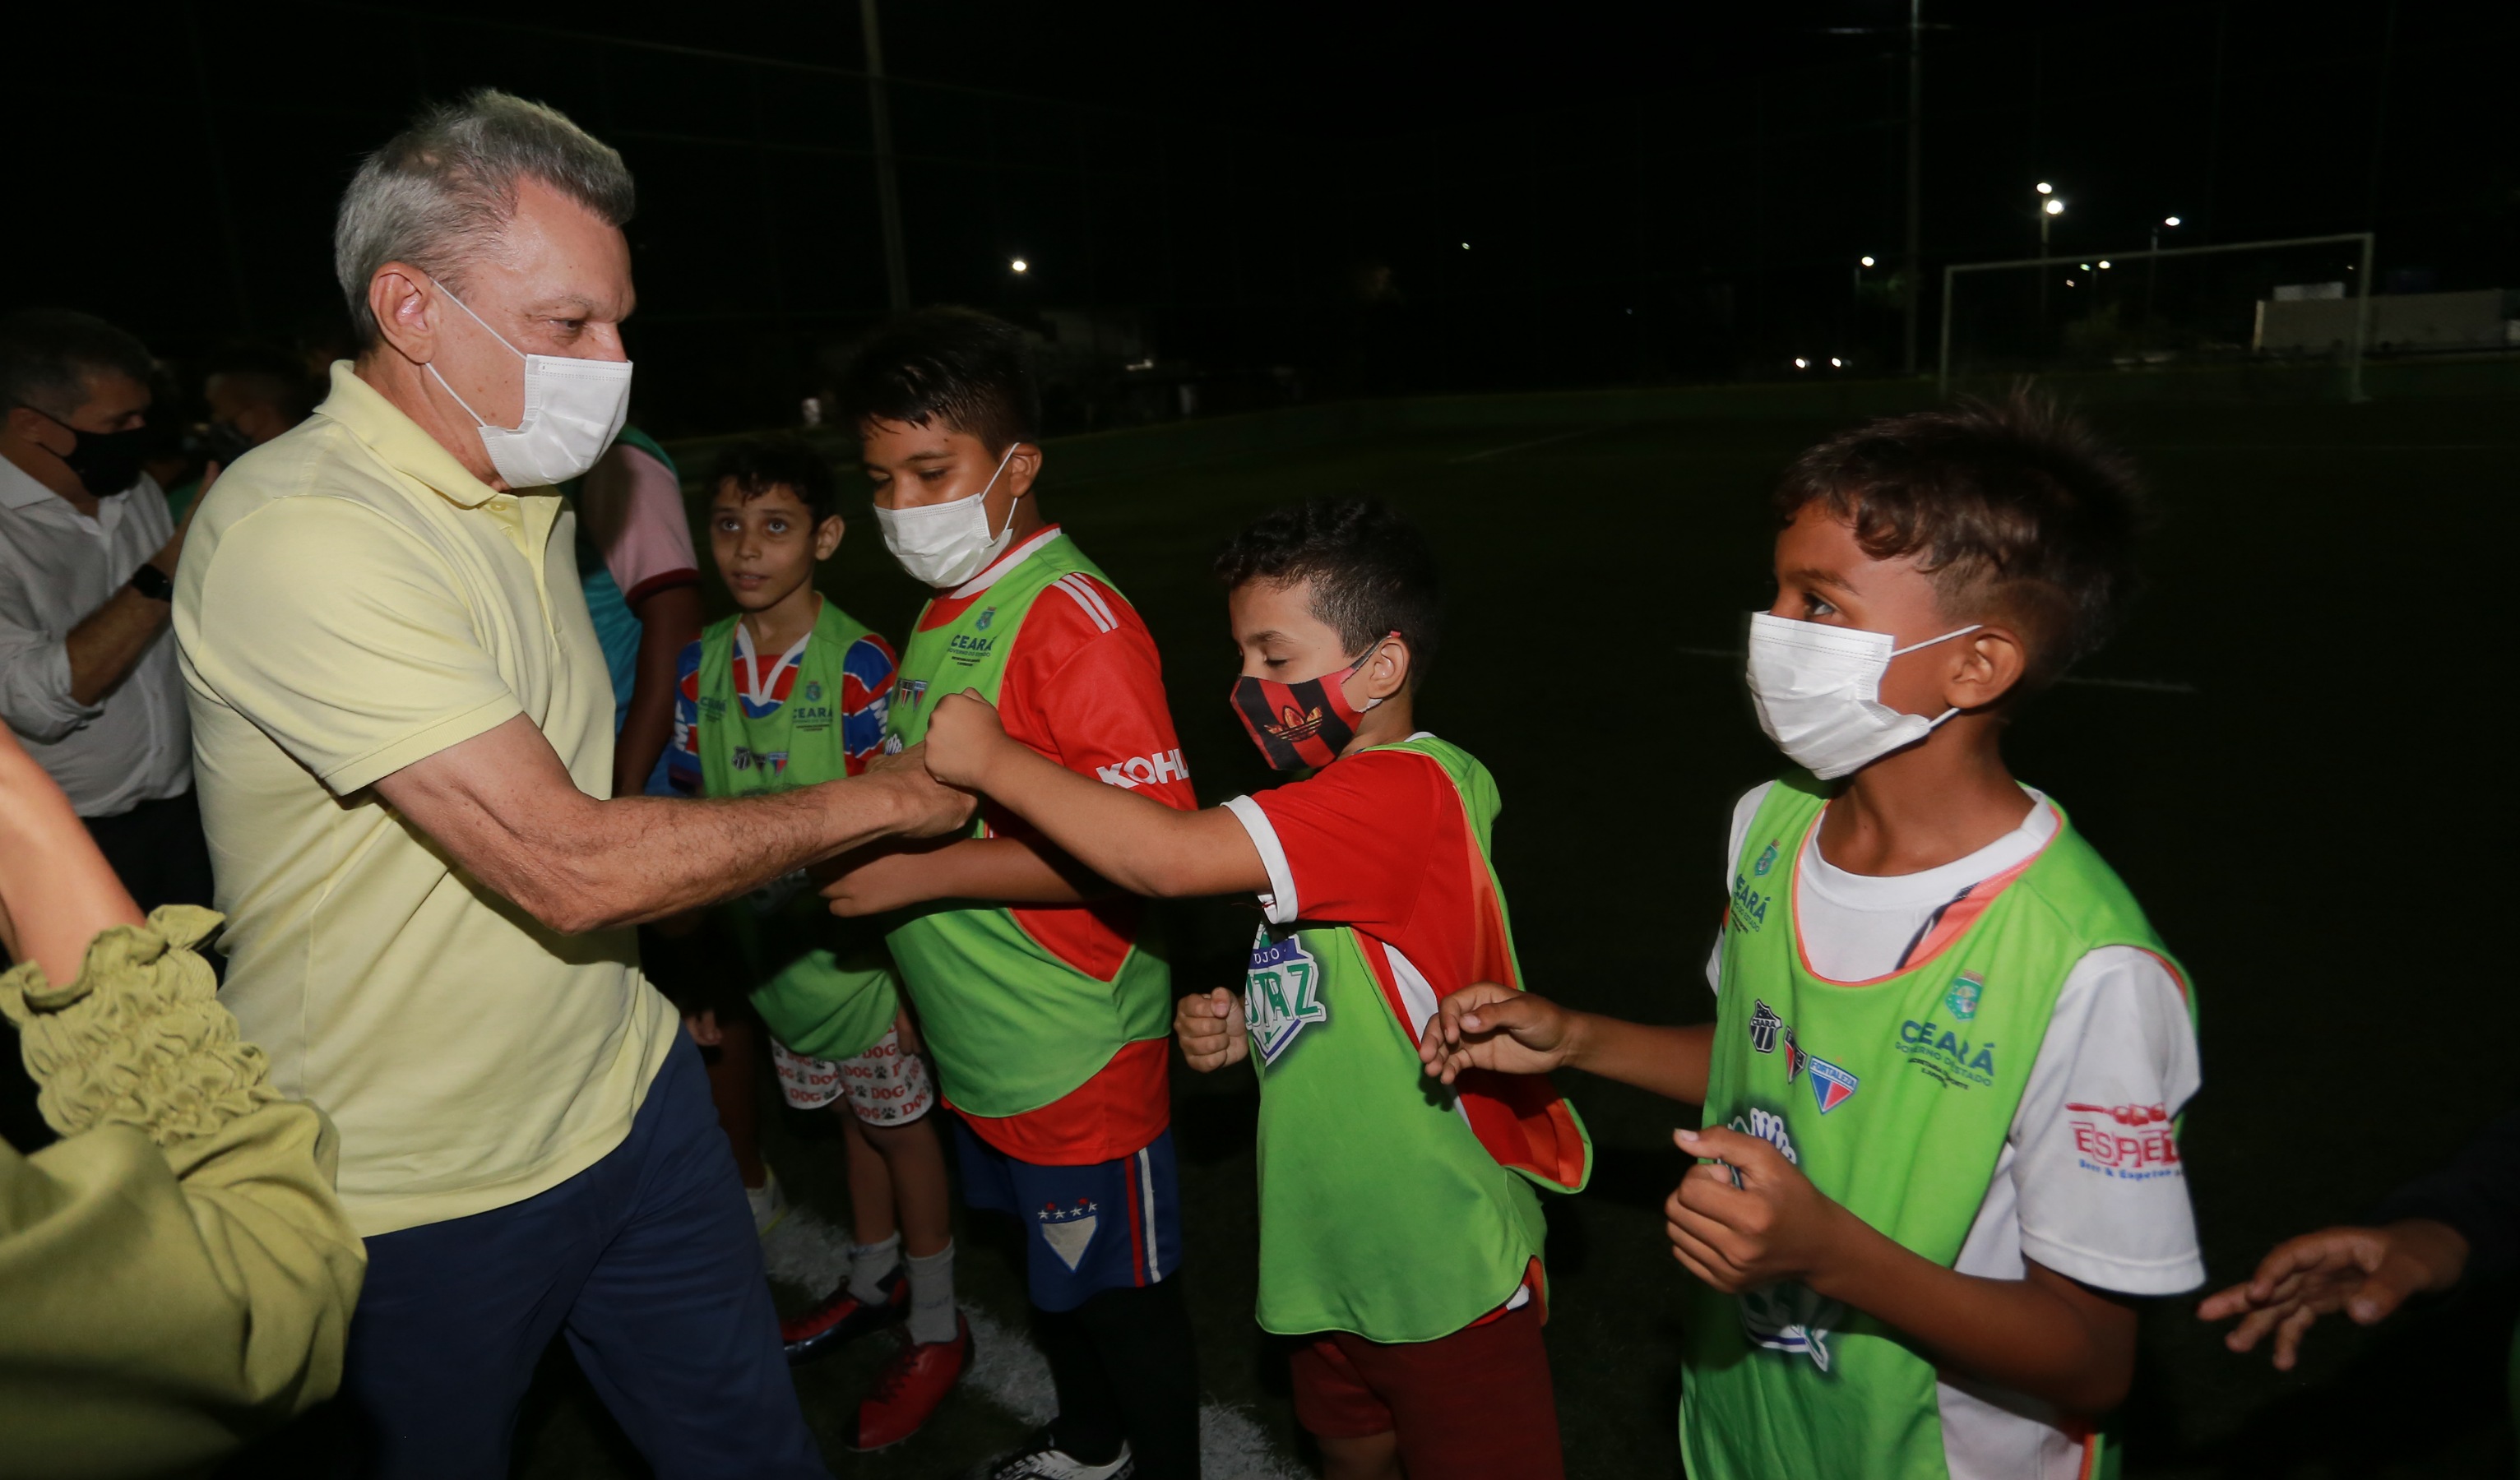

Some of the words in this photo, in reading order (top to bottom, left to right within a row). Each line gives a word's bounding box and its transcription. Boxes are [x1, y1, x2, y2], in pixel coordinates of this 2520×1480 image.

[863, 1043, 896, 1059] DOG
[1901, 1020, 1995, 1076] CEARÁ
[844, 1065, 873, 1079] DOG
[790, 1088, 821, 1103] DOG
[871, 1085, 906, 1100] DOG
